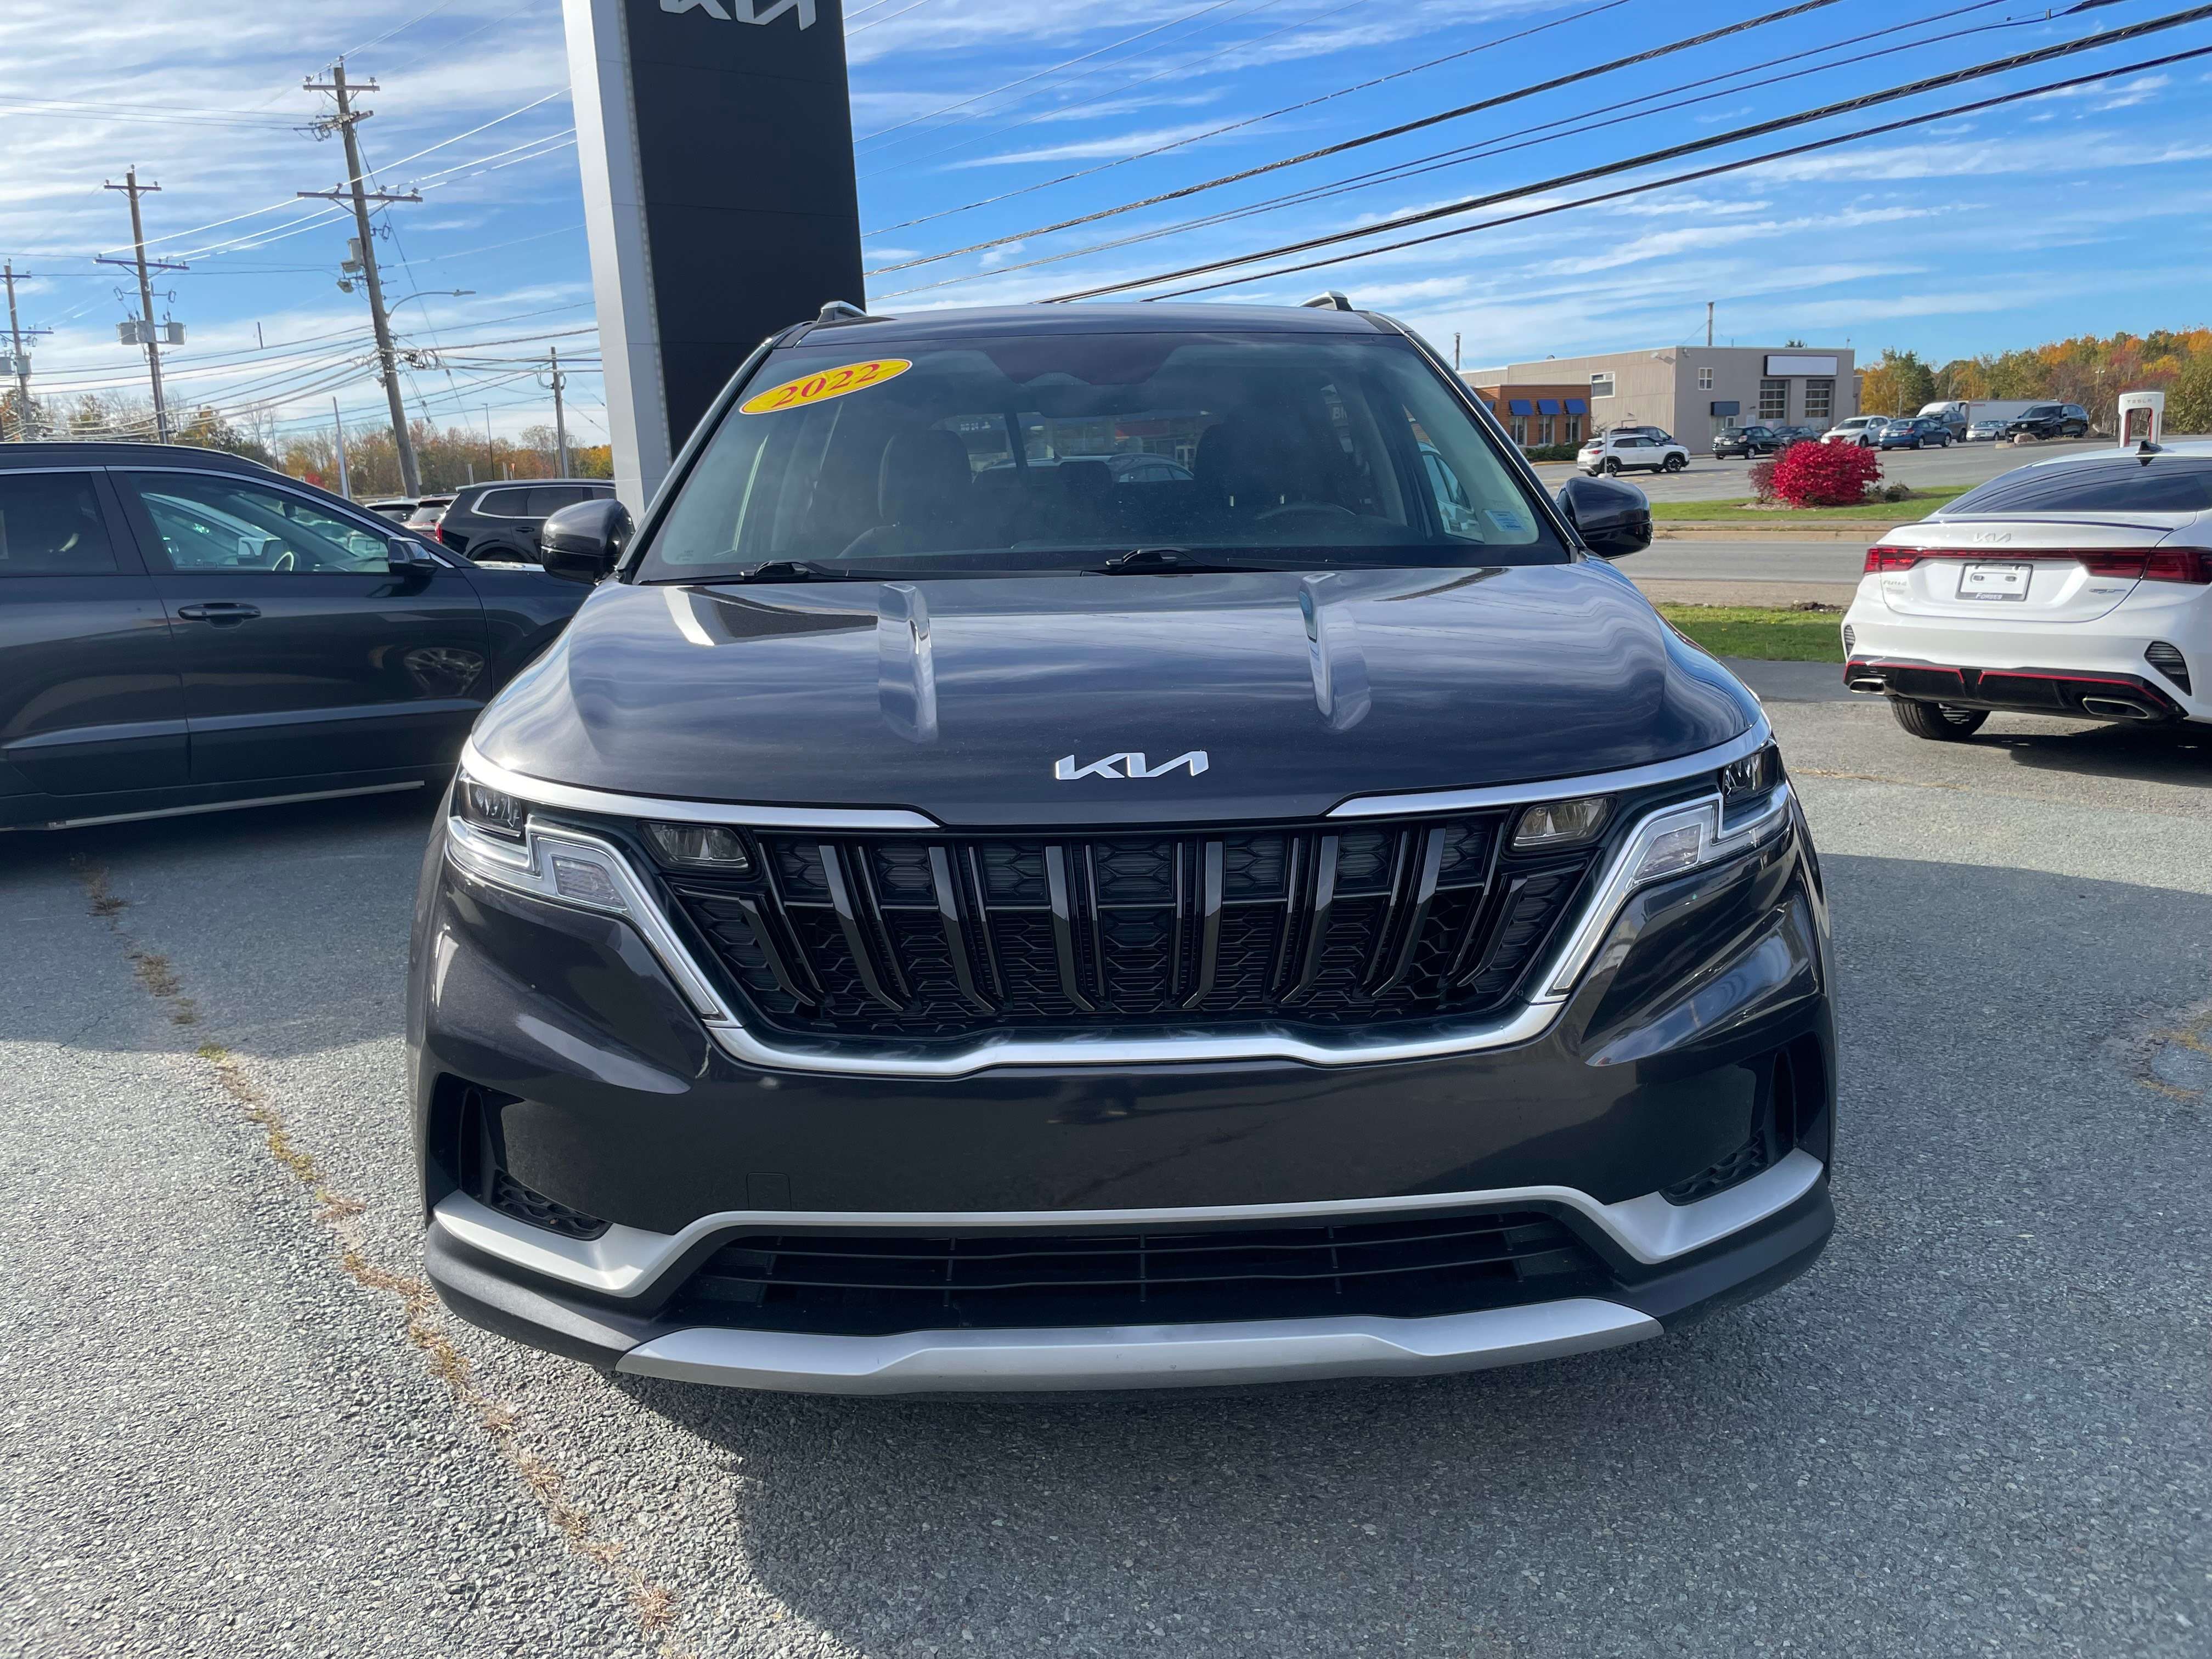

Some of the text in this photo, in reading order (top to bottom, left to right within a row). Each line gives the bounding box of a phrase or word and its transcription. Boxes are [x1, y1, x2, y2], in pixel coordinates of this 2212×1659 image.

[771, 363, 881, 408] 2022
[1973, 532, 2011, 543] KIA
[1054, 751, 1209, 780] KIA
